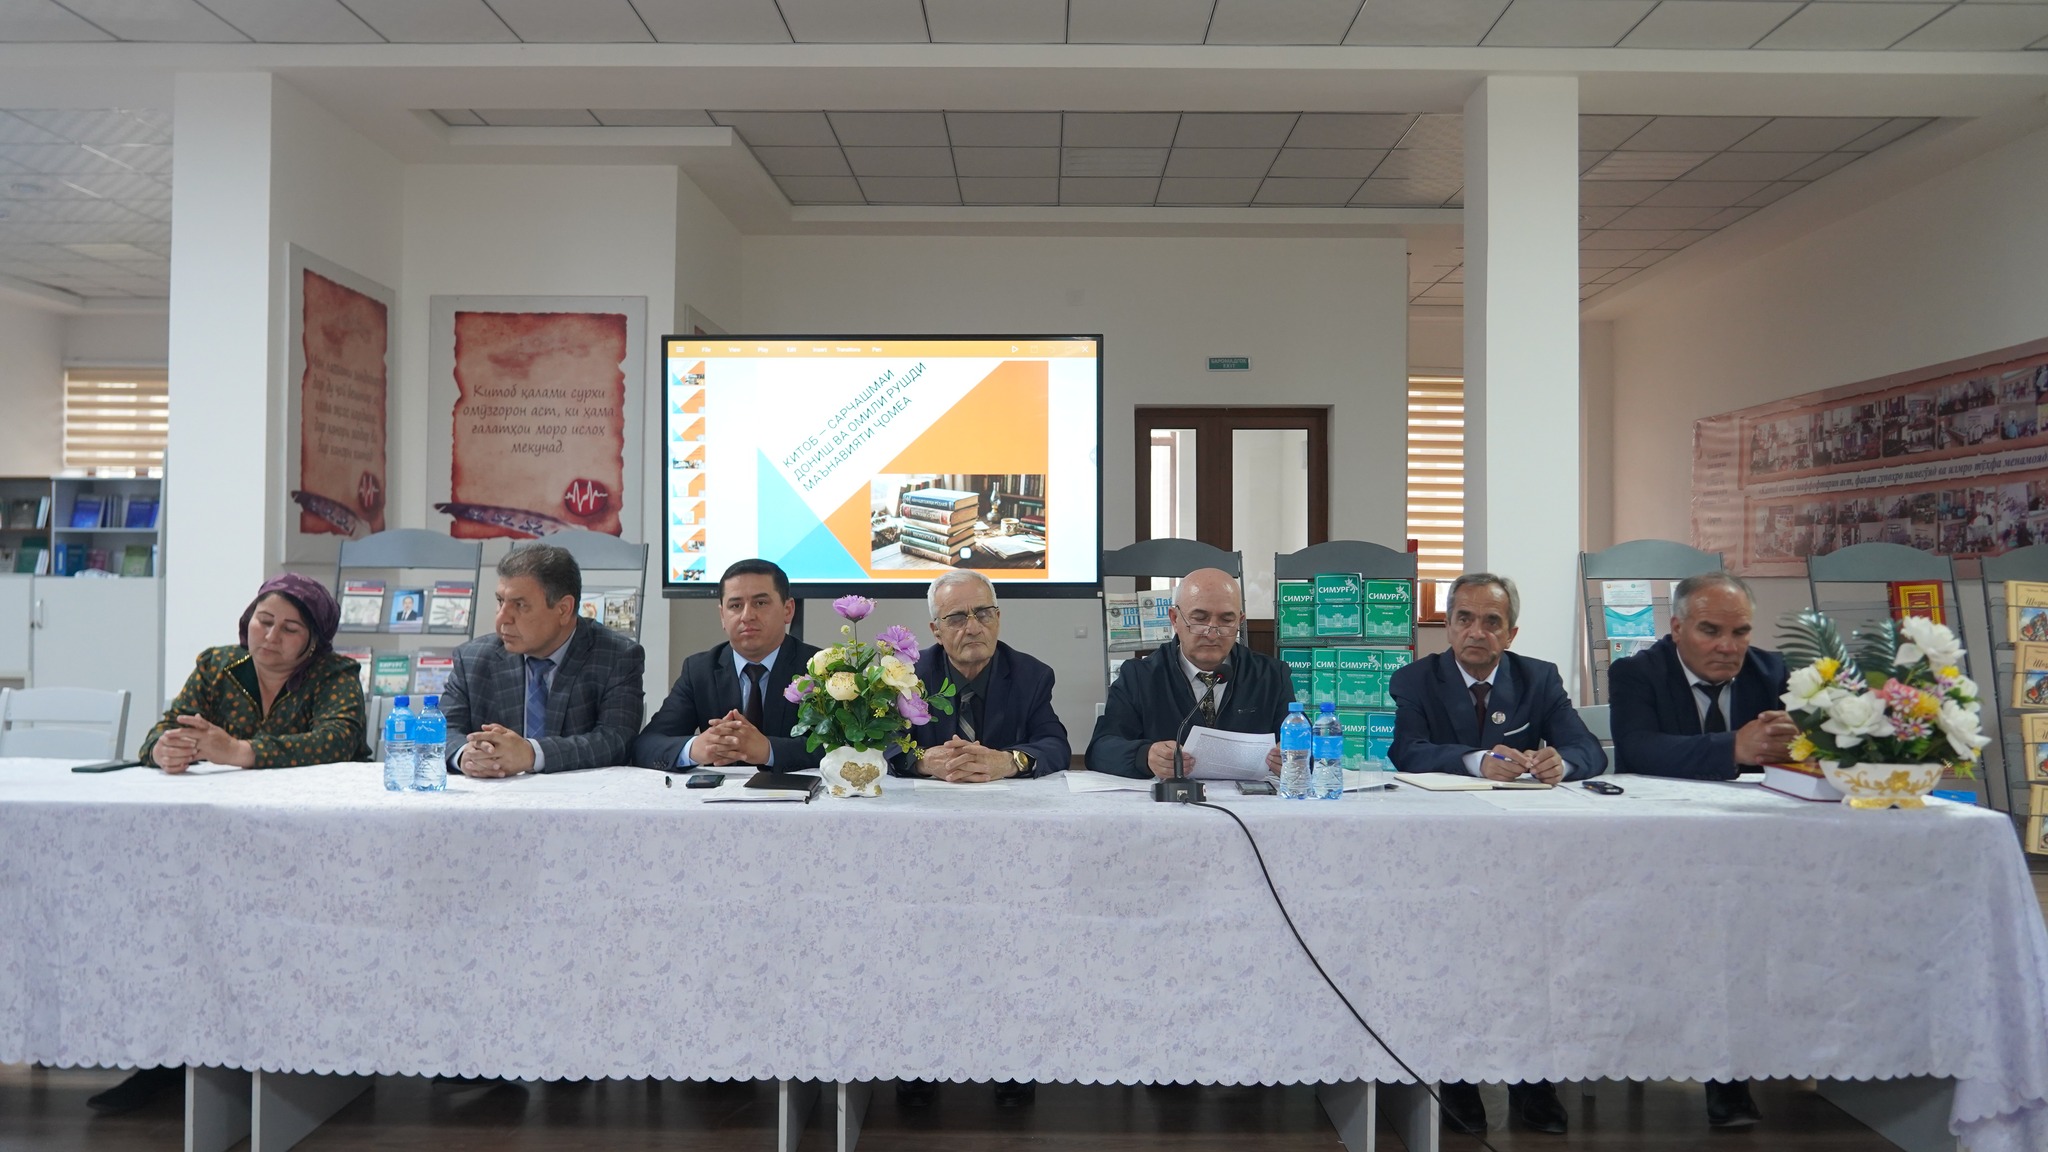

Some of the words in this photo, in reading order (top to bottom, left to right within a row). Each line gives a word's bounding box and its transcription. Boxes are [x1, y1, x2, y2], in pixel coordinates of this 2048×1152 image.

[473, 383, 518, 398] Китоб
[571, 389, 606, 404] сурхи
[531, 407, 561, 418] аст,
[565, 407, 579, 417] ки
[783, 435, 819, 468] КИТОБ
[827, 369, 895, 429] САРЧАШМАИ
[794, 442, 835, 482] ДОНИШ
[832, 430, 850, 446] ВА
[847, 395, 889, 432] ОМИЛИ
[886, 362, 927, 399] РУШДИ
[535, 426, 567, 440] моро
[510, 439, 565, 457] мекунад.
[802, 427, 876, 492] МАЪНАВИЯТИ
[1286, 661, 1312, 669] ИМУР
